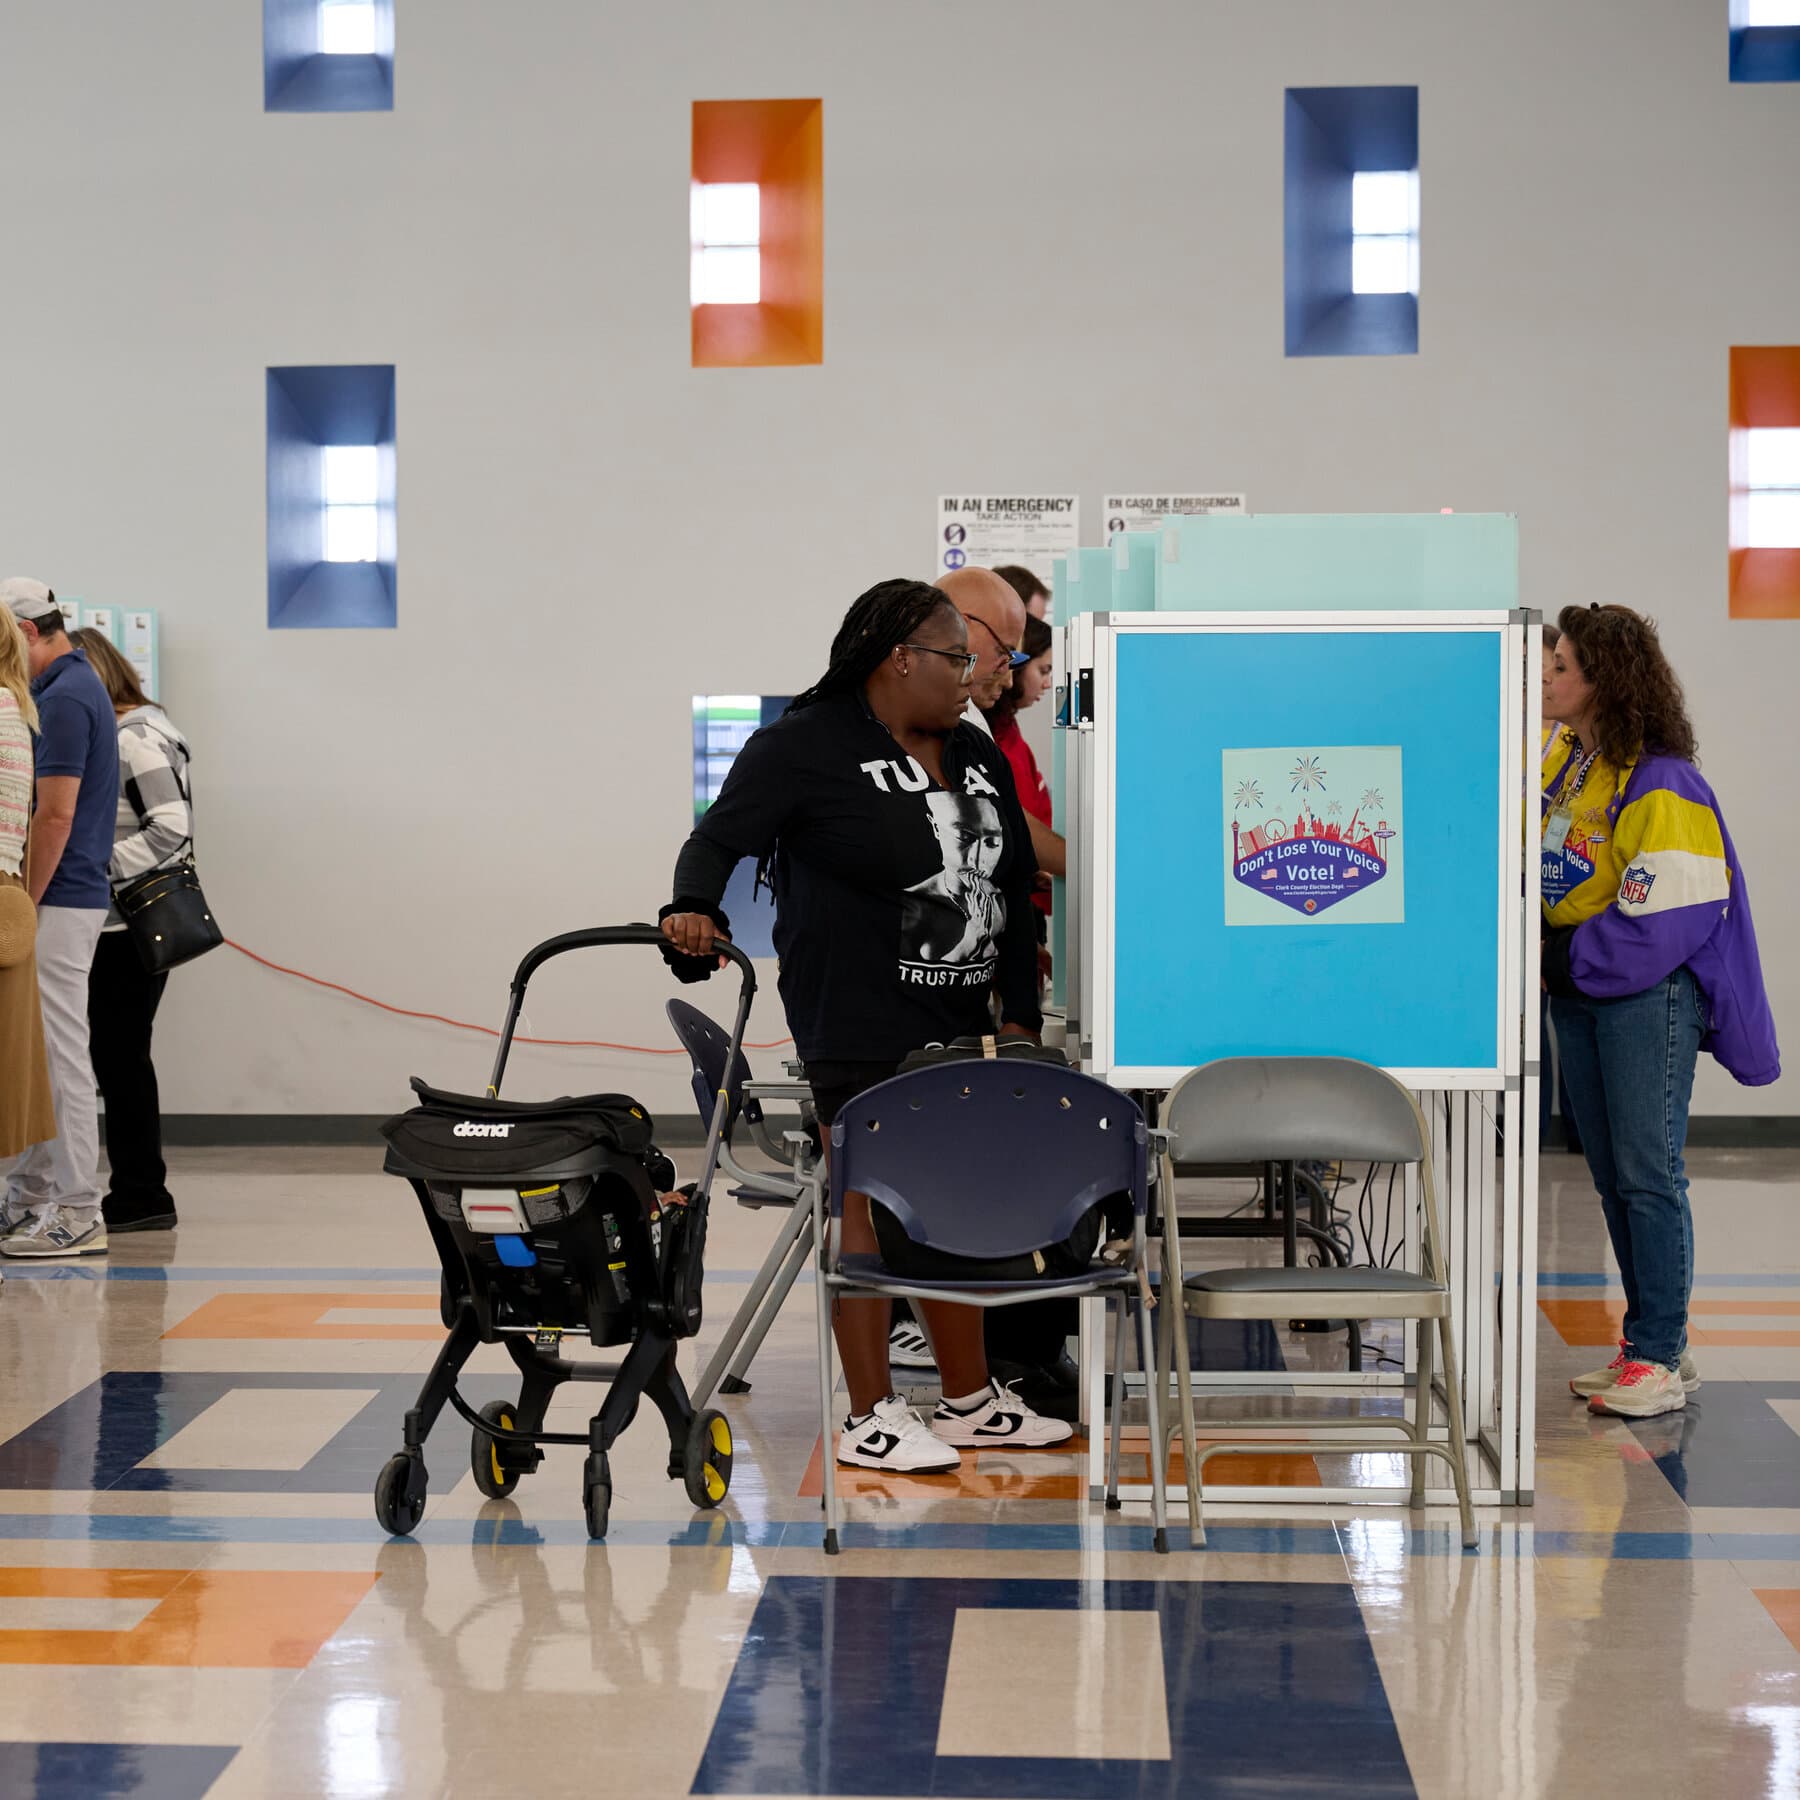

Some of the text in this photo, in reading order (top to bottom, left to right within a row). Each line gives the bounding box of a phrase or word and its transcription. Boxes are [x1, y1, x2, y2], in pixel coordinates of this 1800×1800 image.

[944, 498, 1073, 512] IN AN EMERGENCY
[1108, 498, 1122, 509] EN
[1125, 498, 1153, 508] CASO
[1156, 498, 1170, 508] DE
[976, 512, 1042, 521] TAKE ACTION
[1239, 840, 1380, 877] Don't Lose Your Voice
[1566, 849, 1589, 872] Voice
[1286, 864, 1335, 881] Vote!
[1541, 861, 1564, 880] ote!
[1622, 880, 1647, 902] NFL
[899, 965, 959, 986] TRUST
[453, 1120, 509, 1138] doona
